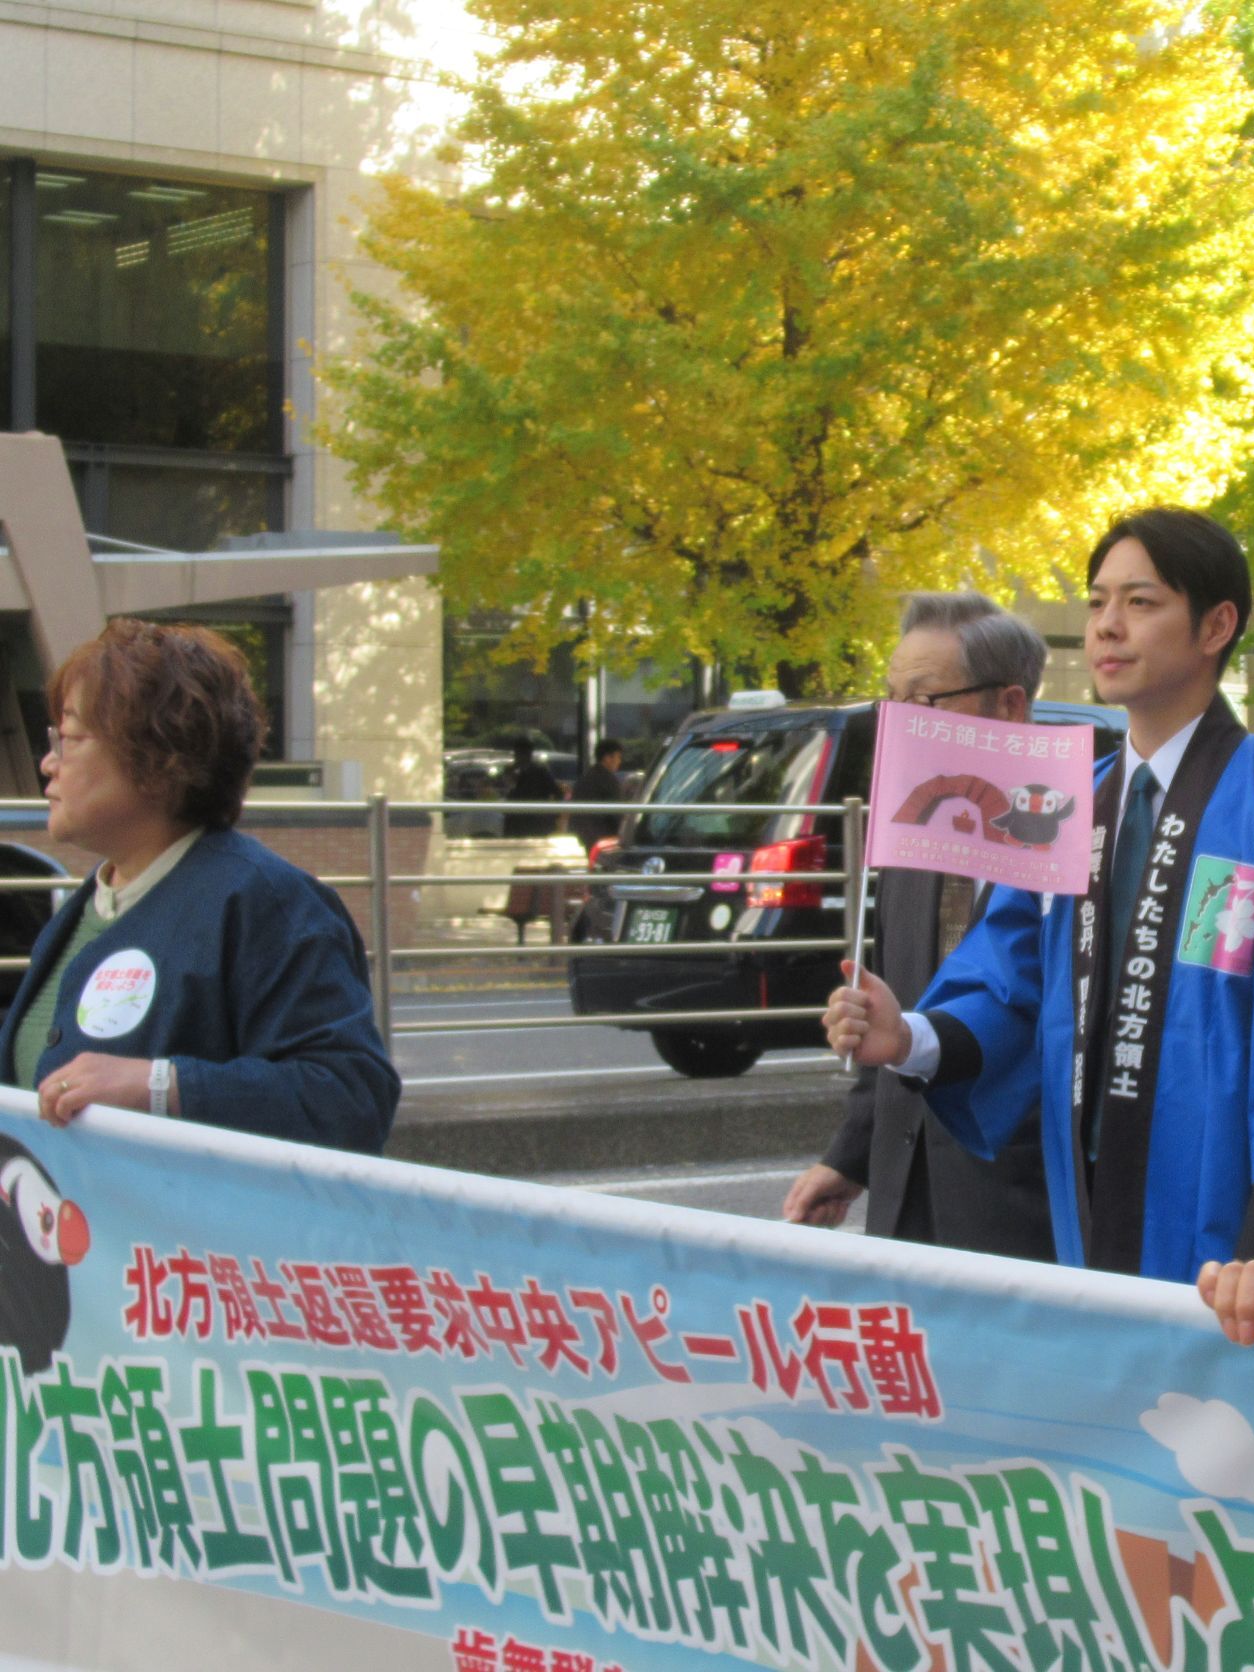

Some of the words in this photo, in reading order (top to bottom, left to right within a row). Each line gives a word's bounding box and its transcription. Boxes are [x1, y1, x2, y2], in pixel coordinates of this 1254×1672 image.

[905, 715, 1086, 759] 北方領土を返せ！
[1109, 813, 1186, 1100] わたしたちの北方領土
[124, 1247, 941, 1420] 北方領土返還要求中央アピール行動
